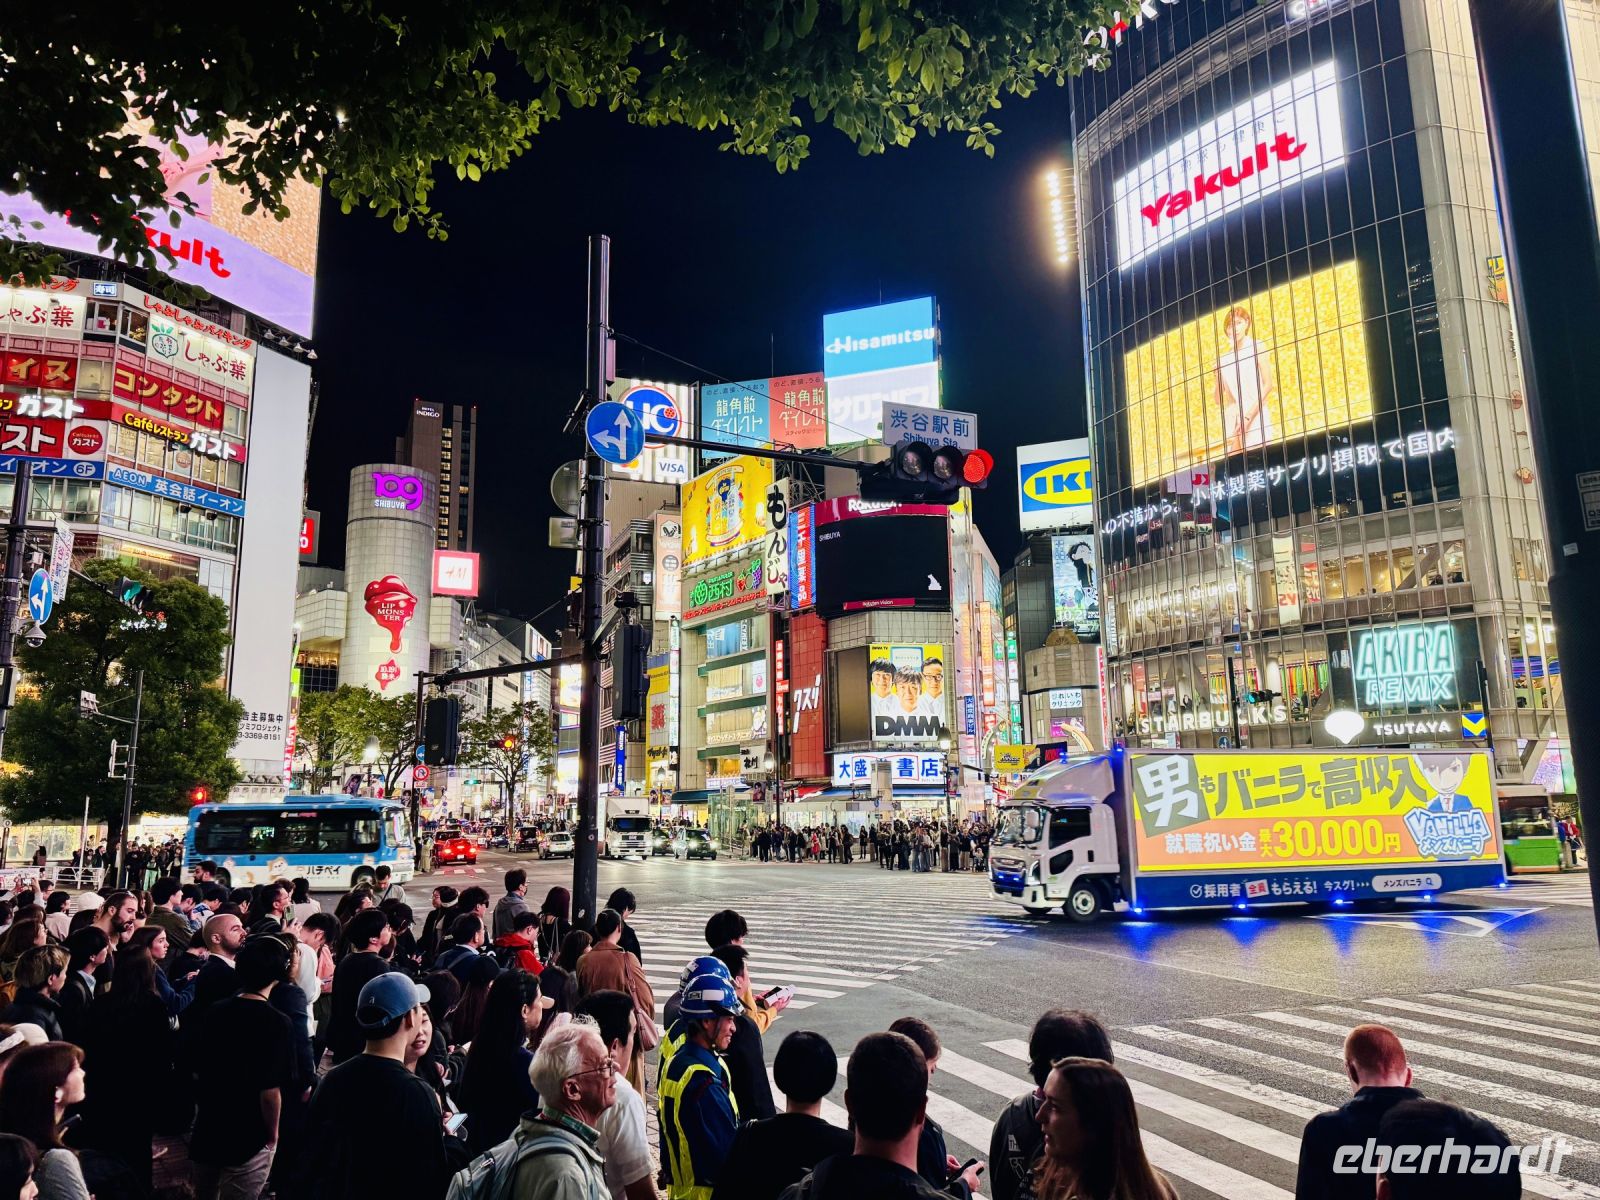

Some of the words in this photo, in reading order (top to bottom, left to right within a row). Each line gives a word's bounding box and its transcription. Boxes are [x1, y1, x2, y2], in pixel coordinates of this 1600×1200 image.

[1140, 132, 1308, 228] Yakult
[144, 294, 252, 350] しゃぶしゃぶバイキング
[825, 326, 935, 355] Hisamitsu
[185, 340, 246, 381] しゃぶ葉
[114, 367, 220, 422] コンタクト
[784, 387, 825, 409] 龍角散
[17, 395, 84, 420] ガスト
[416, 409, 440, 418] INDIGO
[716, 395, 756, 417] 龍角散
[711, 415, 763, 437] ダイレクト
[890, 409, 969, 437] 渋谷駅前
[0, 422, 56, 453] スト
[72, 437, 100, 447] ガスト
[125, 412, 188, 443] Caféレストラン
[190, 431, 237, 460] ガスト
[903, 432, 940, 447] Shibuya
[76, 464, 93, 475] 6F
[113, 468, 148, 486] AEON
[658, 461, 685, 474] VISA
[372, 471, 424, 511] 109
[374, 499, 406, 510] SHIBUYA
[766, 484, 788, 590] もんじゃ
[819, 531, 841, 542] SHIBUYA
[1356, 624, 1456, 681] AKIRA
[1366, 671, 1454, 705] REMIX
[875, 715, 940, 736] DMM
[1140, 705, 1287, 734] STARBUCKS
[1373, 720, 1452, 736] TSUTAYA
[839, 757, 939, 779] 大盛書店
[1137, 754, 1428, 827] 男もバニラで高収入
[1165, 831, 1257, 854] 就職祝い金
[1421, 836, 1483, 852] メンズバニラ
[1204, 883, 1241, 897] 採用者
[1248, 881, 1268, 894] 全員
[1271, 879, 1318, 895] もらえる!
[1383, 878, 1422, 888] メンズバニラ
